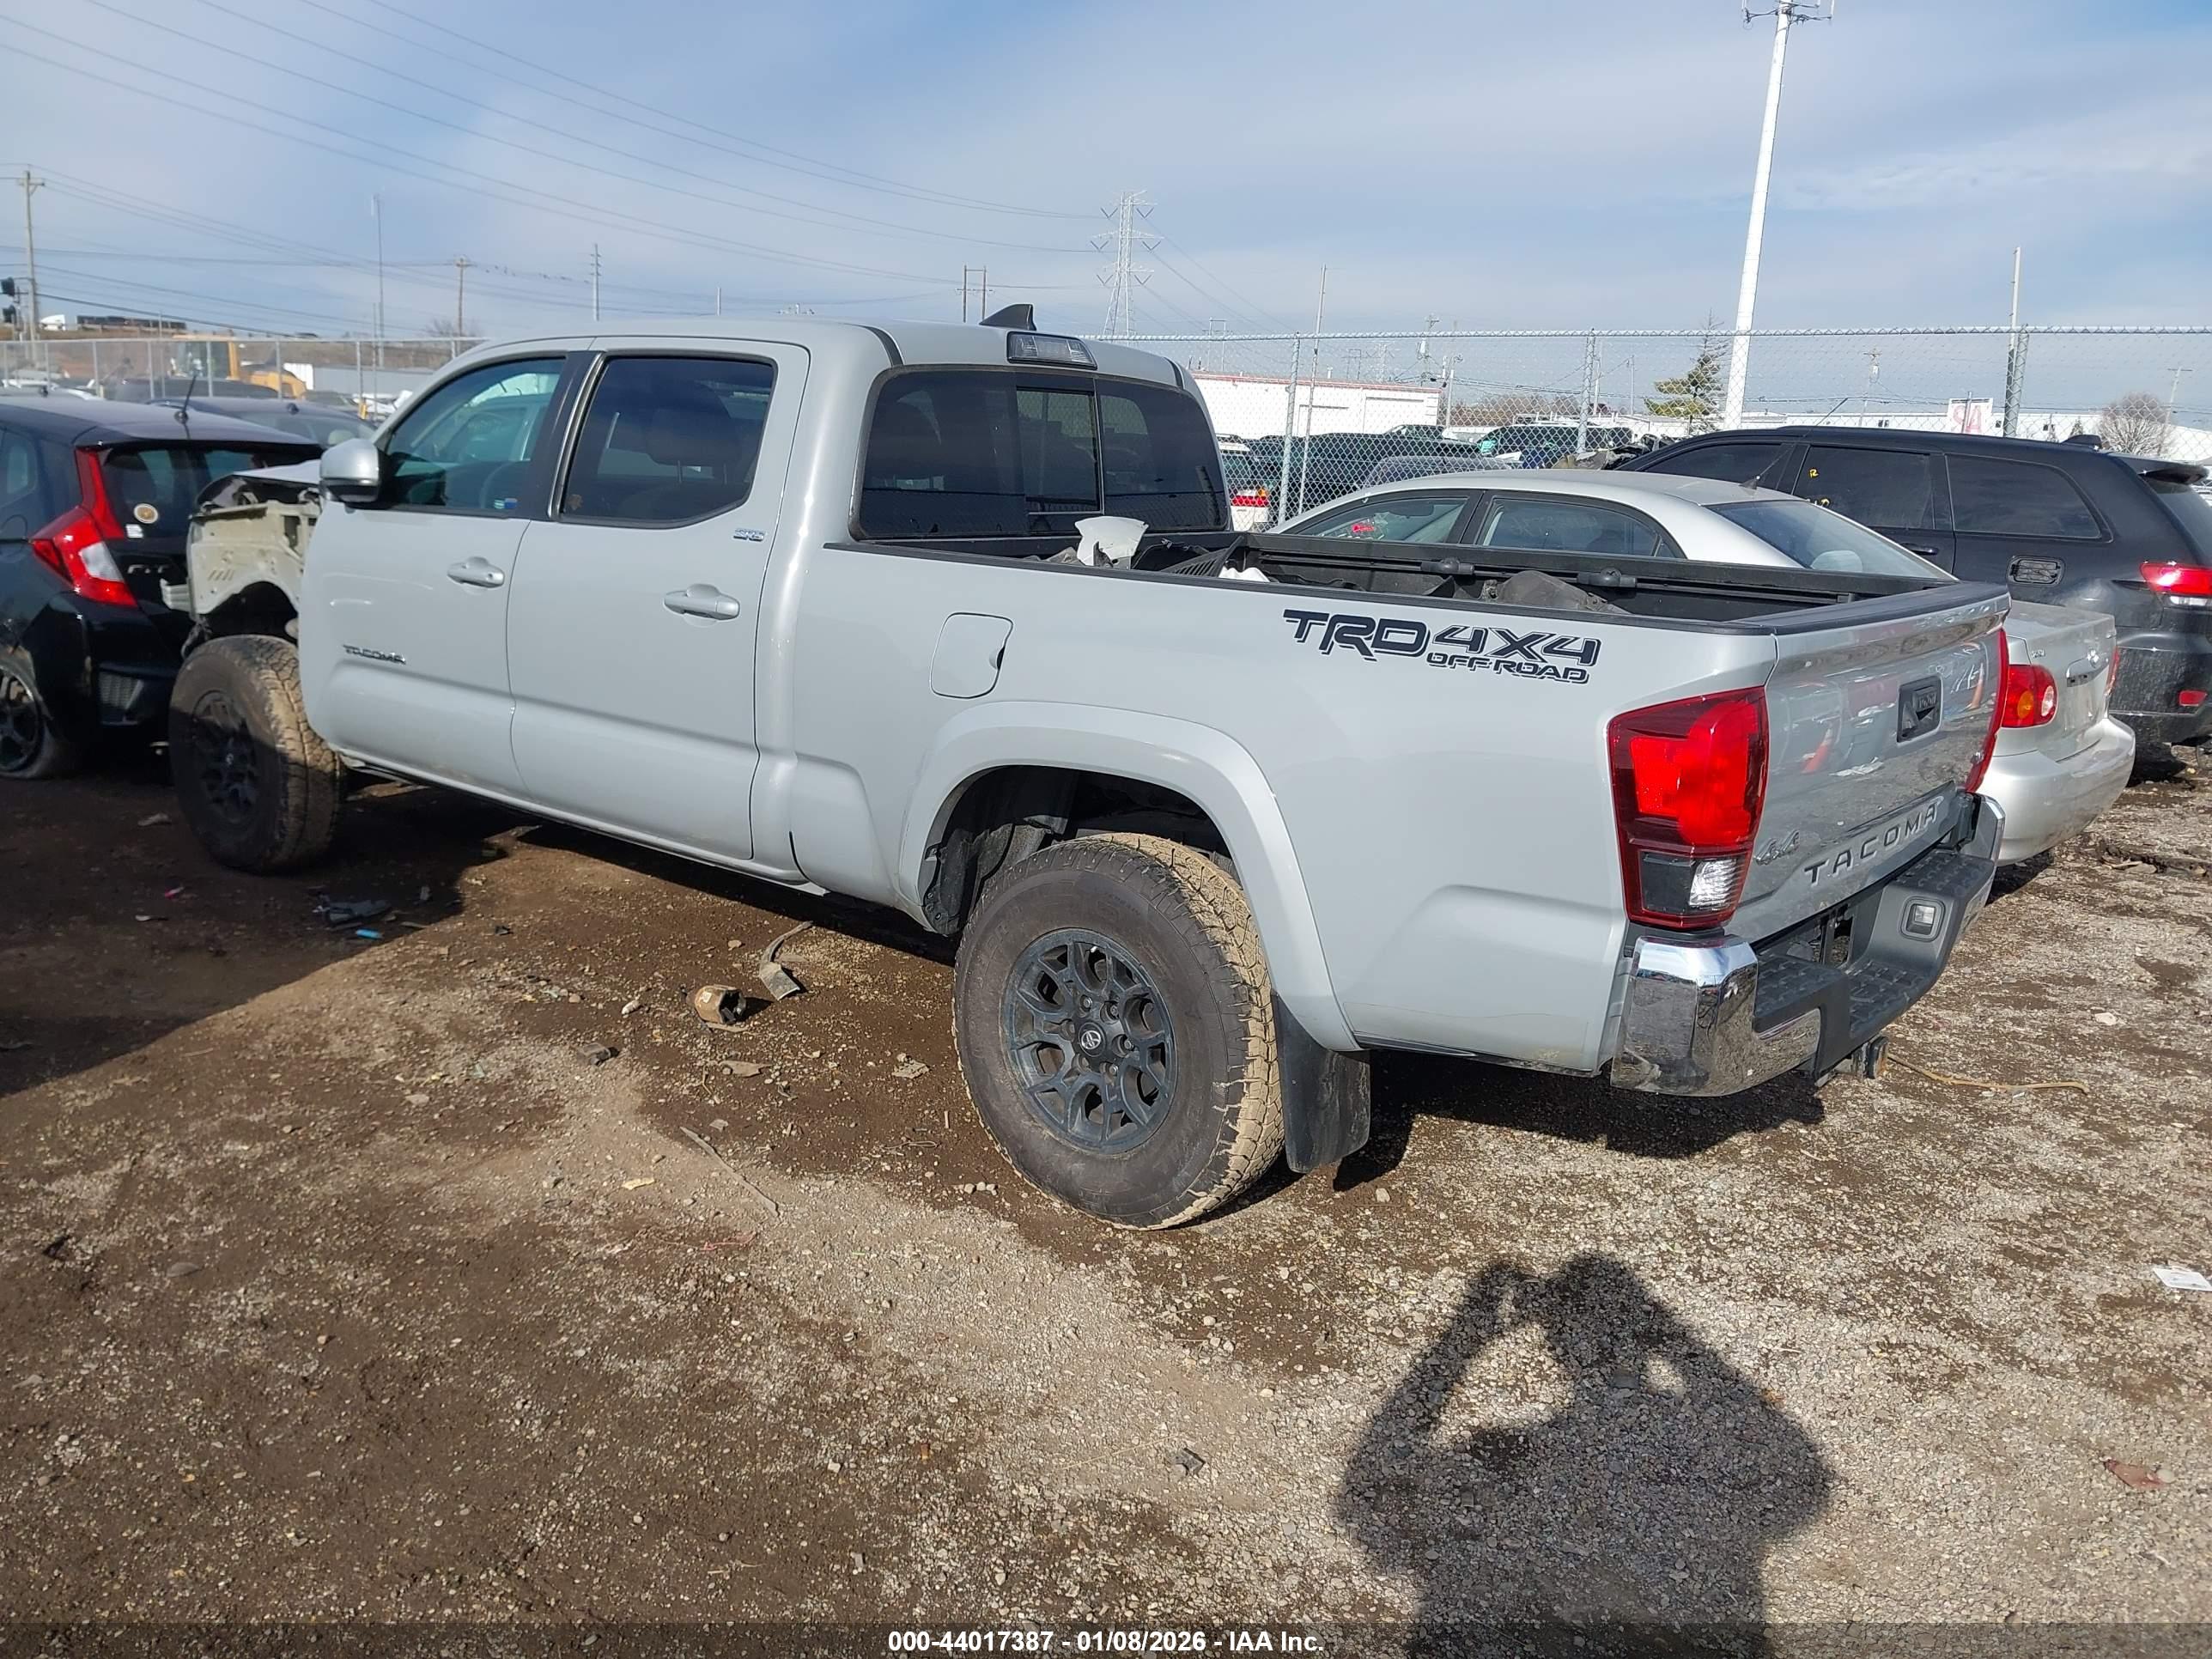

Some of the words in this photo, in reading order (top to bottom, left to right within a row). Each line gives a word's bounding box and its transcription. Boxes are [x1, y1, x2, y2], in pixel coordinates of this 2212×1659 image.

[343, 644, 406, 665] TACOMA
[1283, 609, 1431, 662] TRD
[1425, 652, 1492, 672] OFF
[1491, 658, 1589, 684] ROAD
[1804, 801, 1939, 887] TACOMA
